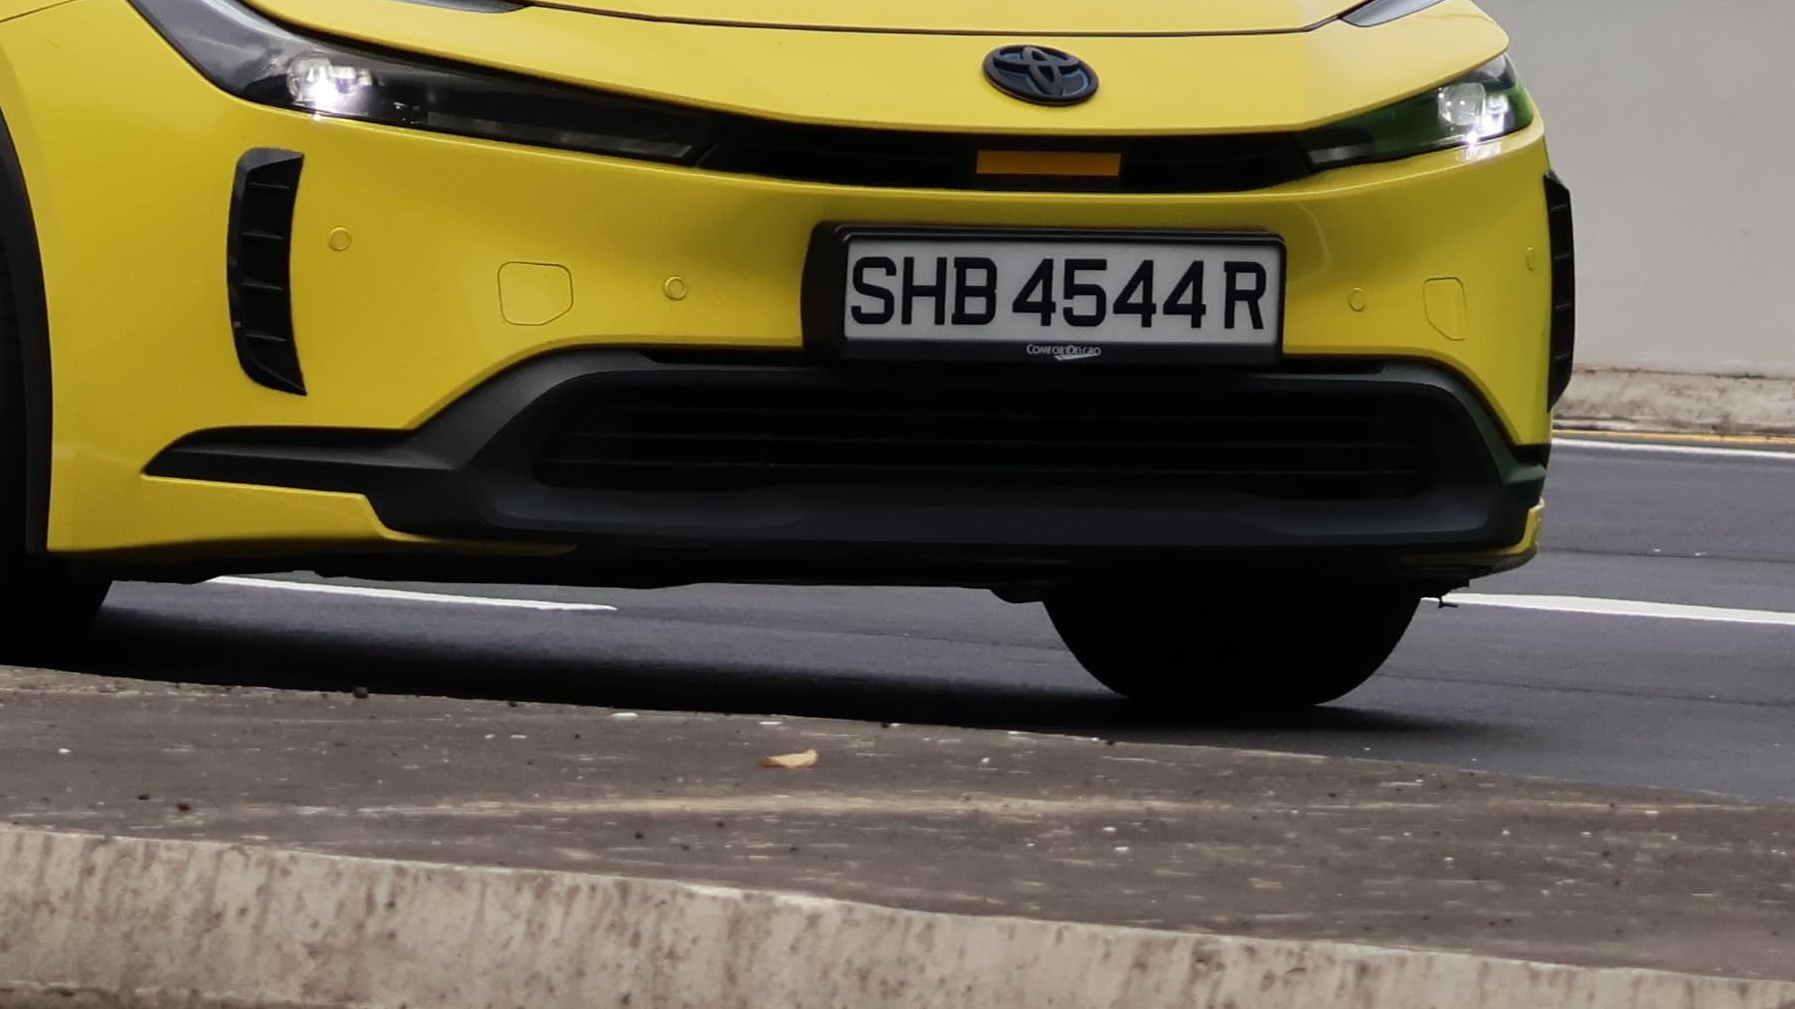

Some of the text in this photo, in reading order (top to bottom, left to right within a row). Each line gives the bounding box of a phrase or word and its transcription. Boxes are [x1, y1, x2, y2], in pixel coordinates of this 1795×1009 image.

[850, 256, 1267, 330] SHB 4544 R
